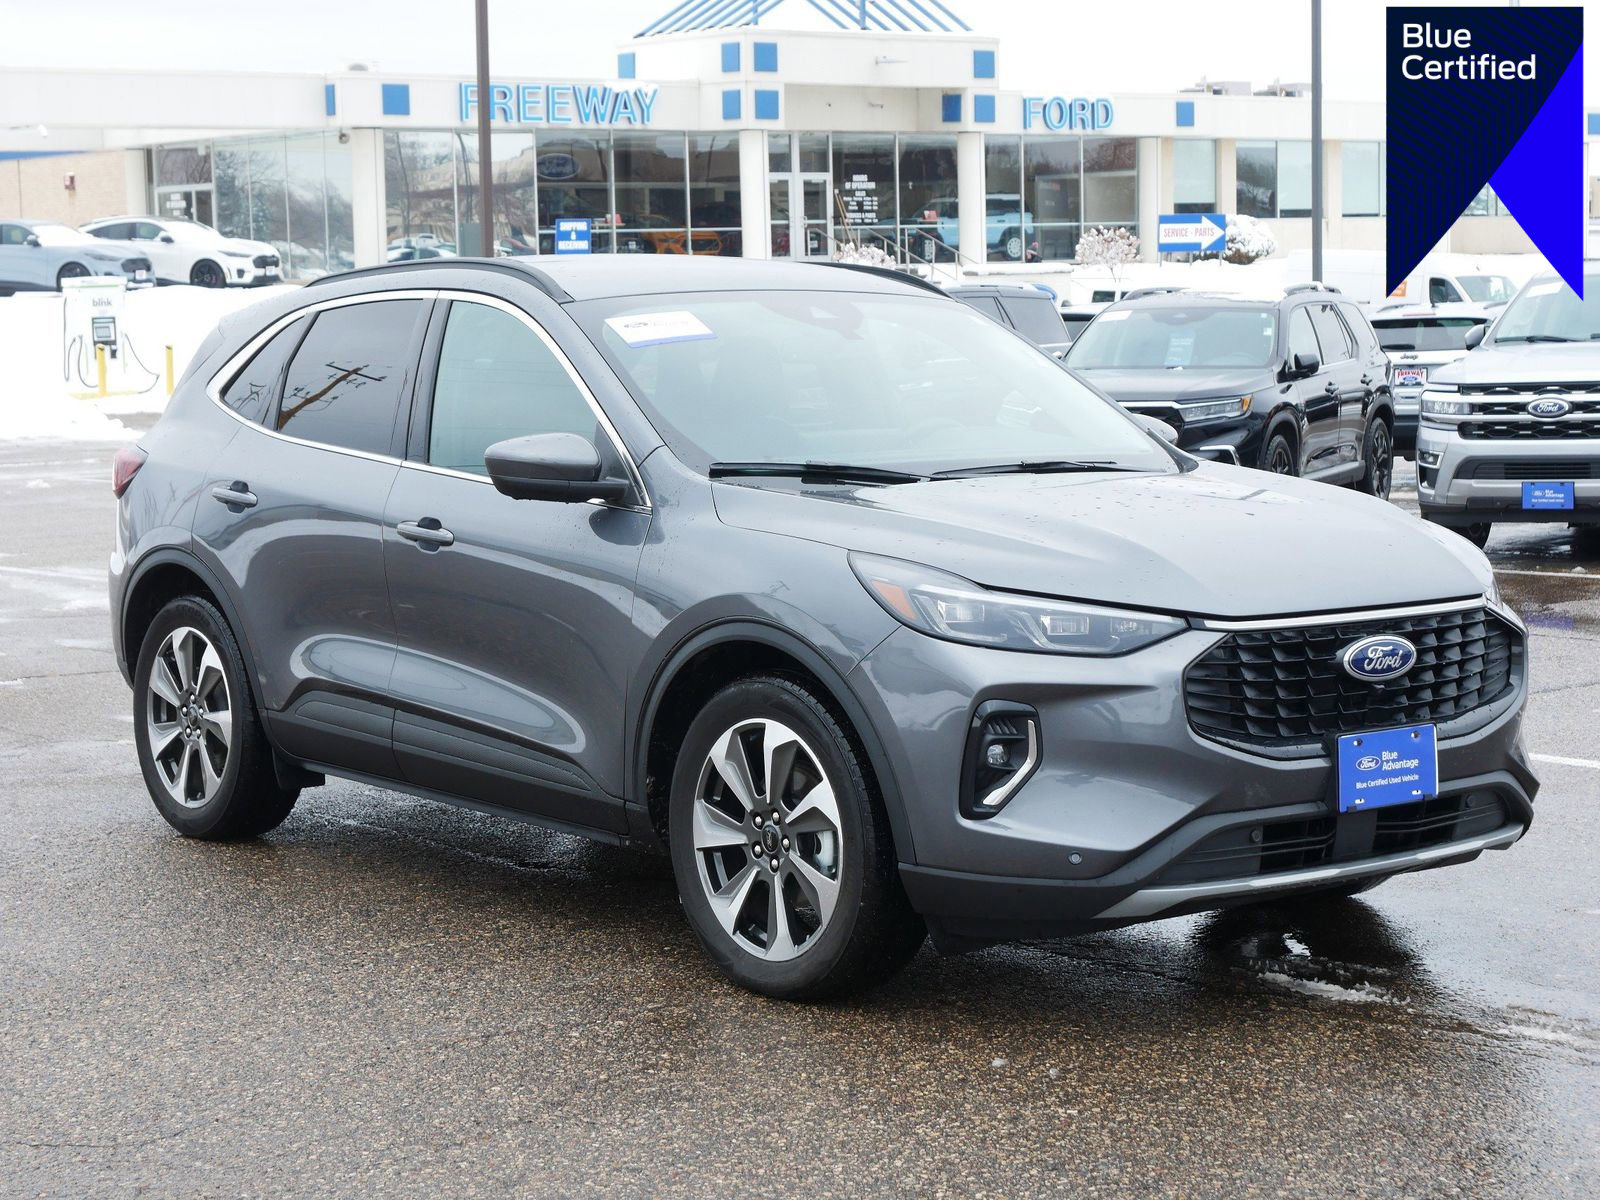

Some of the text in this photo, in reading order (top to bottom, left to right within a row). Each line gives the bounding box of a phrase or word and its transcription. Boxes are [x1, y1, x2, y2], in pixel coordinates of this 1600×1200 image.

[459, 82, 658, 124] FREEWAY
[1023, 96, 1114, 130] FORD
[1163, 227, 1188, 238] SERVICE
[1194, 227, 1215, 237] PARTS
[92, 298, 112, 307] blink
[1537, 401, 1559, 412] Ford
[1364, 645, 1403, 670] Ford
[1382, 750, 1398, 760] Blue
[1360, 758, 1376, 769] Ford
[1382, 758, 1419, 771] Advantage
[1356, 773, 1419, 789] Blue Certified Used Vehicle
